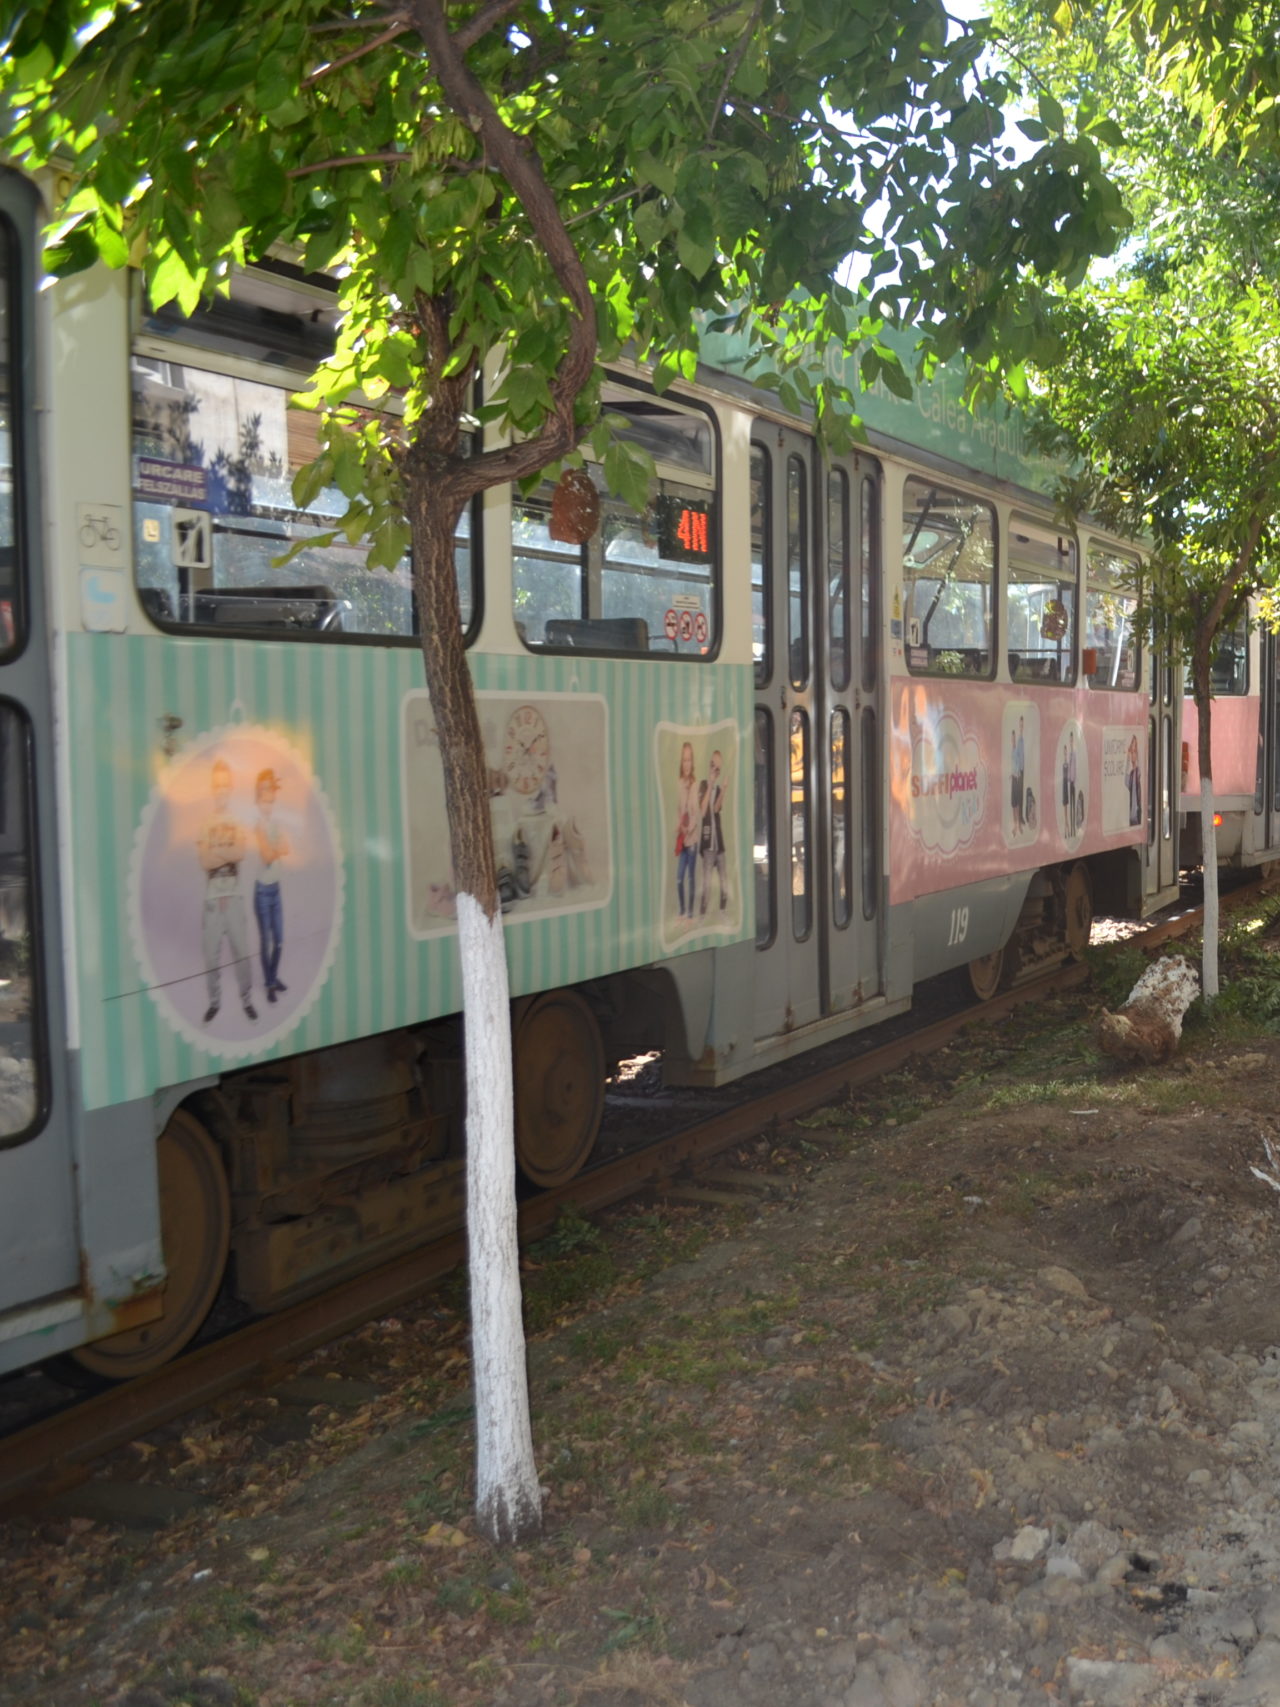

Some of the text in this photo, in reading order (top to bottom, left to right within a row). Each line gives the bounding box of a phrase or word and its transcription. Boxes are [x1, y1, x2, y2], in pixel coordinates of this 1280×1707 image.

[917, 379, 967, 434] Calea
[140, 462, 205, 484] URCARE
[676, 509, 708, 553] 4N
[948, 906, 969, 946] 119
